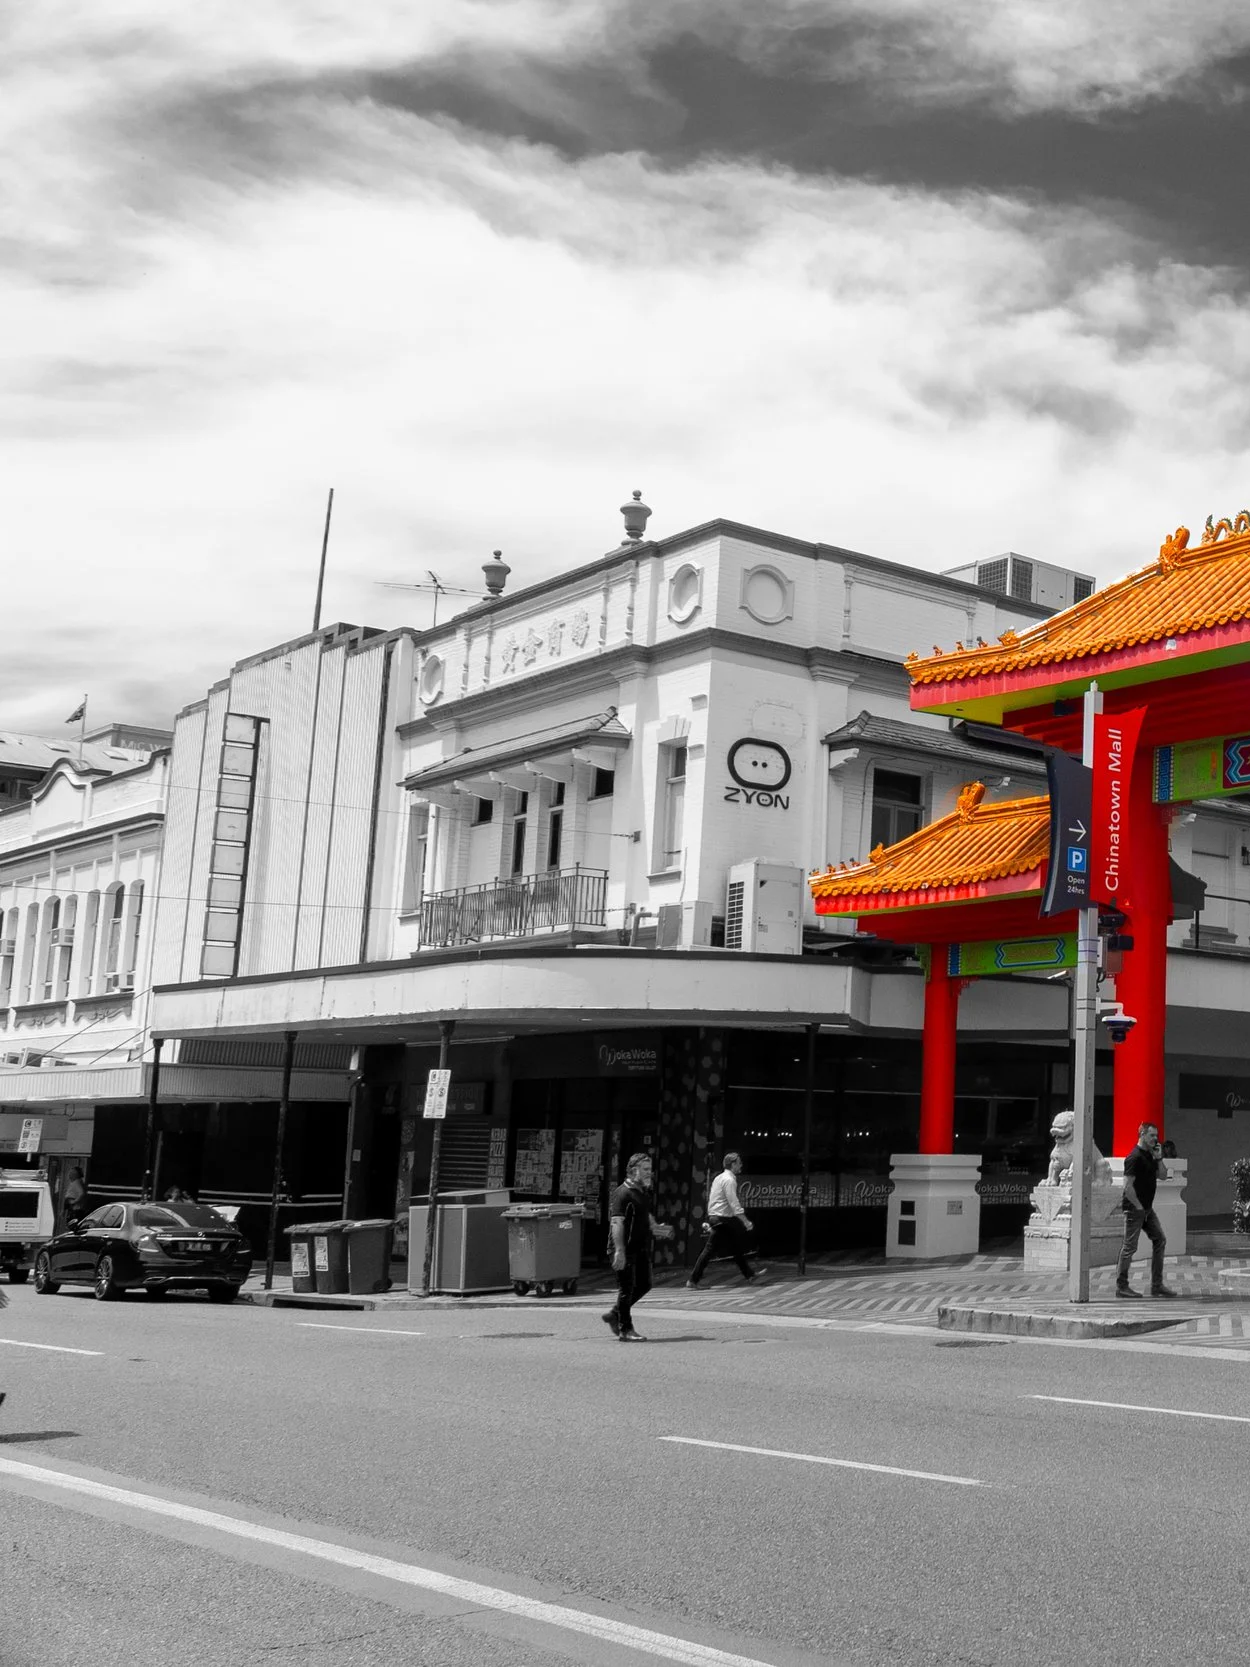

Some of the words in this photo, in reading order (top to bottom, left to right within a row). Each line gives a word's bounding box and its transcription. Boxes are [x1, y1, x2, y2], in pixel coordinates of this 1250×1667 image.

[1108, 728, 1122, 772] Mall
[724, 786, 789, 810] ZYON
[1105, 780, 1121, 891] Chinatown
[1067, 875, 1085, 886] Open
[1067, 885, 1085, 895] 24hrs
